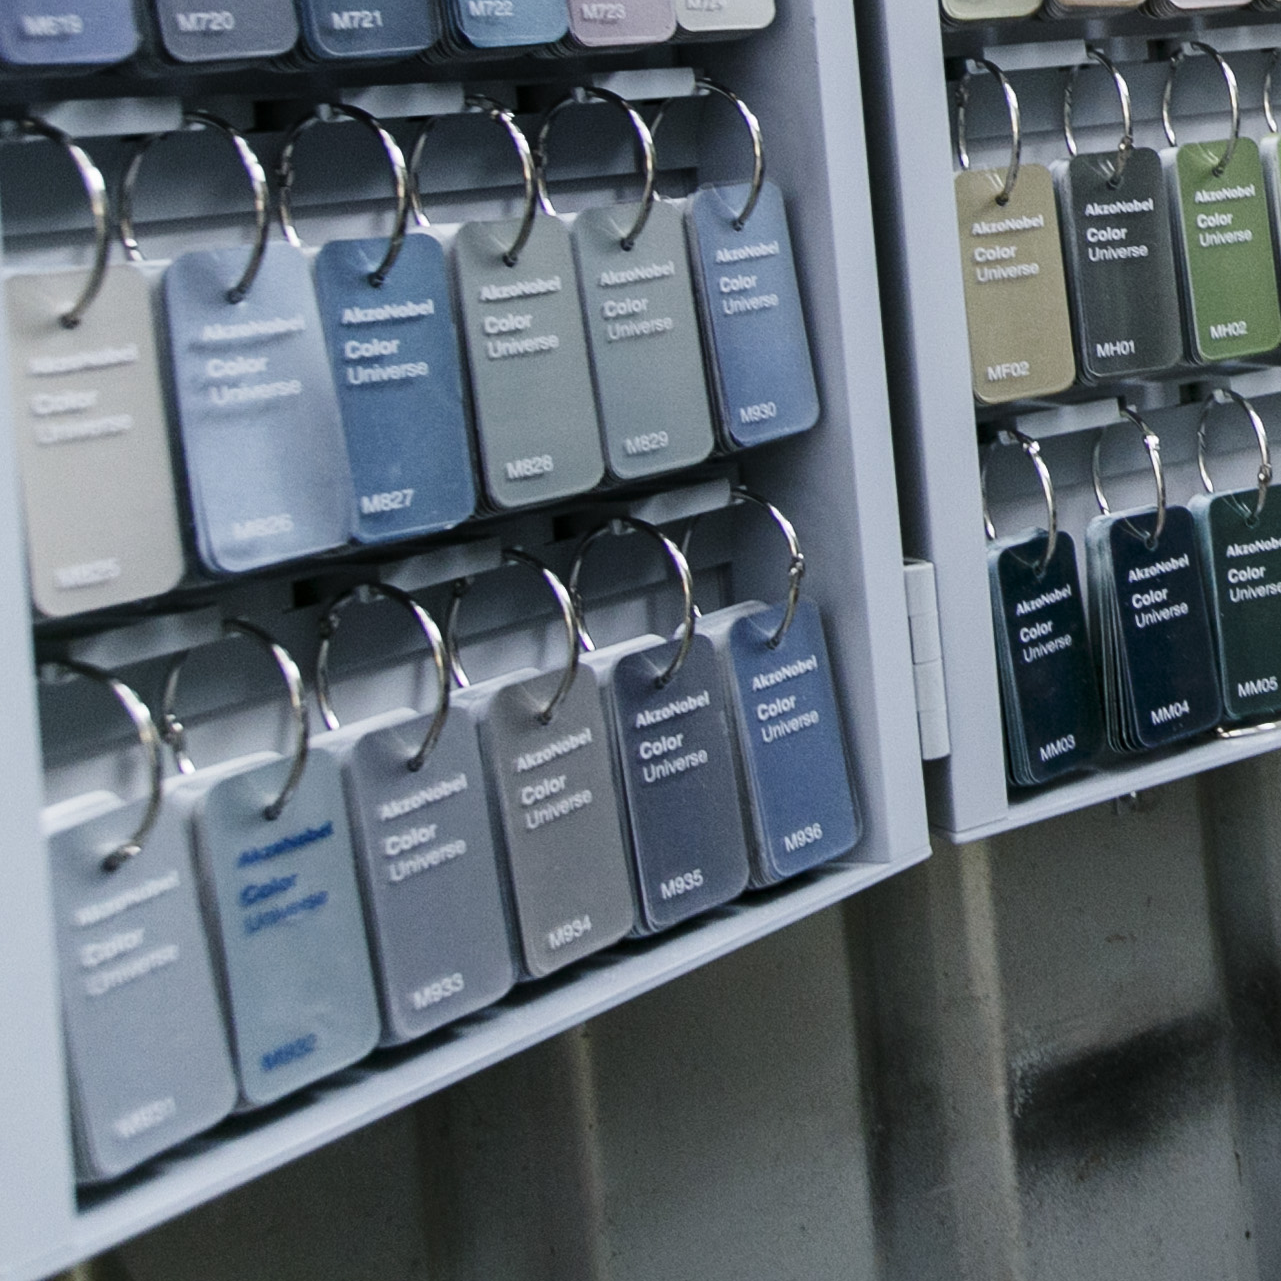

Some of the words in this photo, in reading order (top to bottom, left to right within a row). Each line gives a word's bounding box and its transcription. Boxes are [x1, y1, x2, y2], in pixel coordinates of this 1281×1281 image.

[468, 0, 513, 16] M722
[331, 10, 382, 29] M721
[1195, 184, 1255, 202] AkzoNobel
[1085, 199, 1153, 215] AkzoNobel
[973, 214, 1044, 233] AkzoNobel
[1197, 213, 1233, 228] Color
[1087, 227, 1127, 242] Color
[1199, 230, 1252, 246] Universe
[716, 241, 779, 261] AkzoNobel
[974, 246, 1017, 261] Color
[1088, 245, 1148, 261] Universe
[976, 263, 1039, 281] Universe
[481, 276, 561, 299] AkzoNobel
[719, 275, 757, 292] Color
[343, 299, 434, 323] AkzoNobel
[722, 294, 778, 314] Universe
[484, 314, 532, 332] Color
[1210, 321, 1247, 338] MH02
[344, 339, 400, 358] Color
[487, 335, 559, 357] Universe
[1096, 340, 1135, 357] MH01
[347, 362, 429, 384] Universe
[987, 361, 1029, 379] MF02
[739, 402, 776, 422] M930
[506, 455, 553, 477] M828
[362, 489, 415, 512] M827
[1129, 554, 1189, 582] AkzoNobel
[1228, 566, 1265, 583] Color
[1016, 584, 1071, 615] AkzoNobel
[1132, 589, 1168, 608] Color
[1135, 602, 1188, 628] Universe
[1020, 621, 1052, 642] Color
[1023, 634, 1072, 662] Universe
[753, 655, 817, 690] AkzoNobel
[1238, 676, 1278, 697] MM05
[636, 691, 709, 727] AkzoNobel
[757, 696, 796, 720] Color
[1151, 700, 1190, 724] MM04
[762, 711, 819, 742] Universe
[514, 729, 592, 771] AkzoNobel
[640, 734, 683, 759] Color
[1040, 735, 1076, 761] MM03
[643, 750, 707, 782] Universe
[521, 775, 566, 804] Color
[525, 790, 592, 829] Universe
[784, 823, 822, 851] M936
[660, 869, 703, 899] M935
[548, 915, 592, 948] M934
